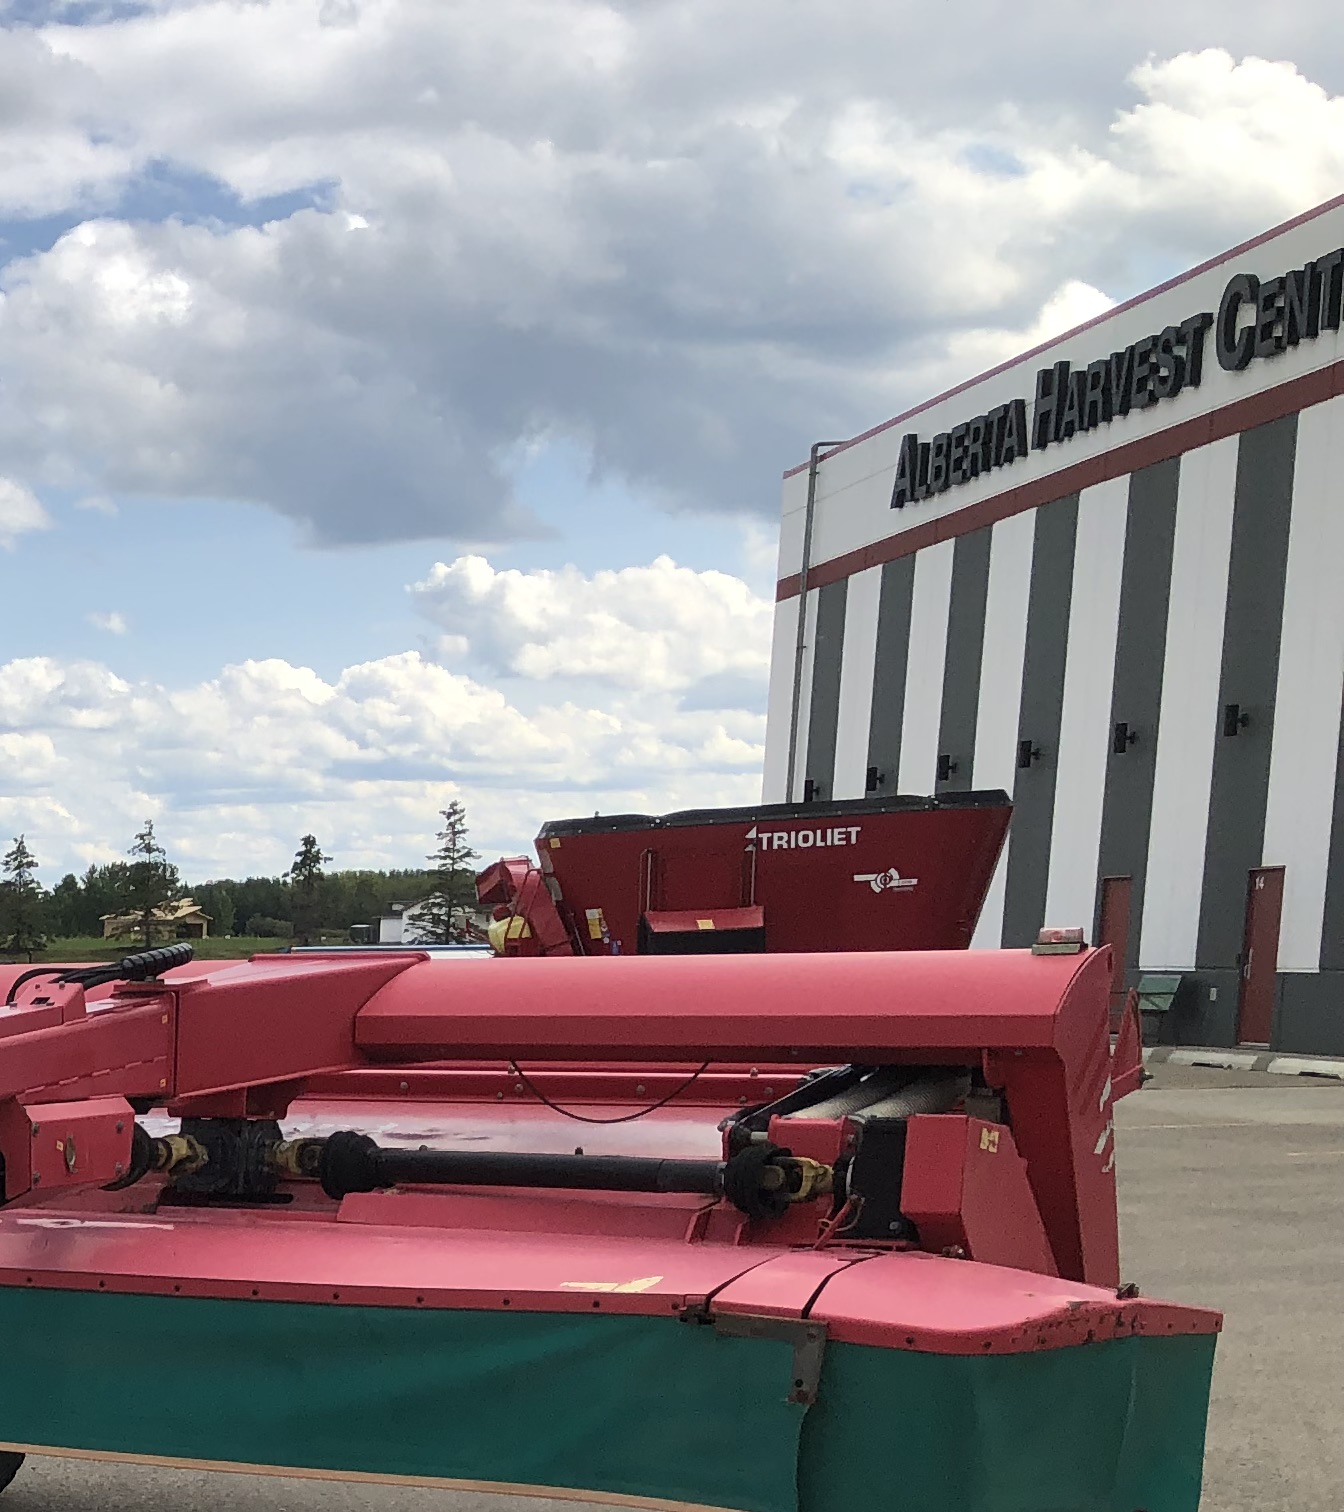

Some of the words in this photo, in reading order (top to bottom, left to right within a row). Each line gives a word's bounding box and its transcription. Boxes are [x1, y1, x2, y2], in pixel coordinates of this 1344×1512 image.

[890, 399, 1028, 509] ALBERTA
[1032, 312, 1214, 451] HARVEST
[1216, 248, 1344, 371] CENT
[758, 826, 861, 850] TRIOLIET
